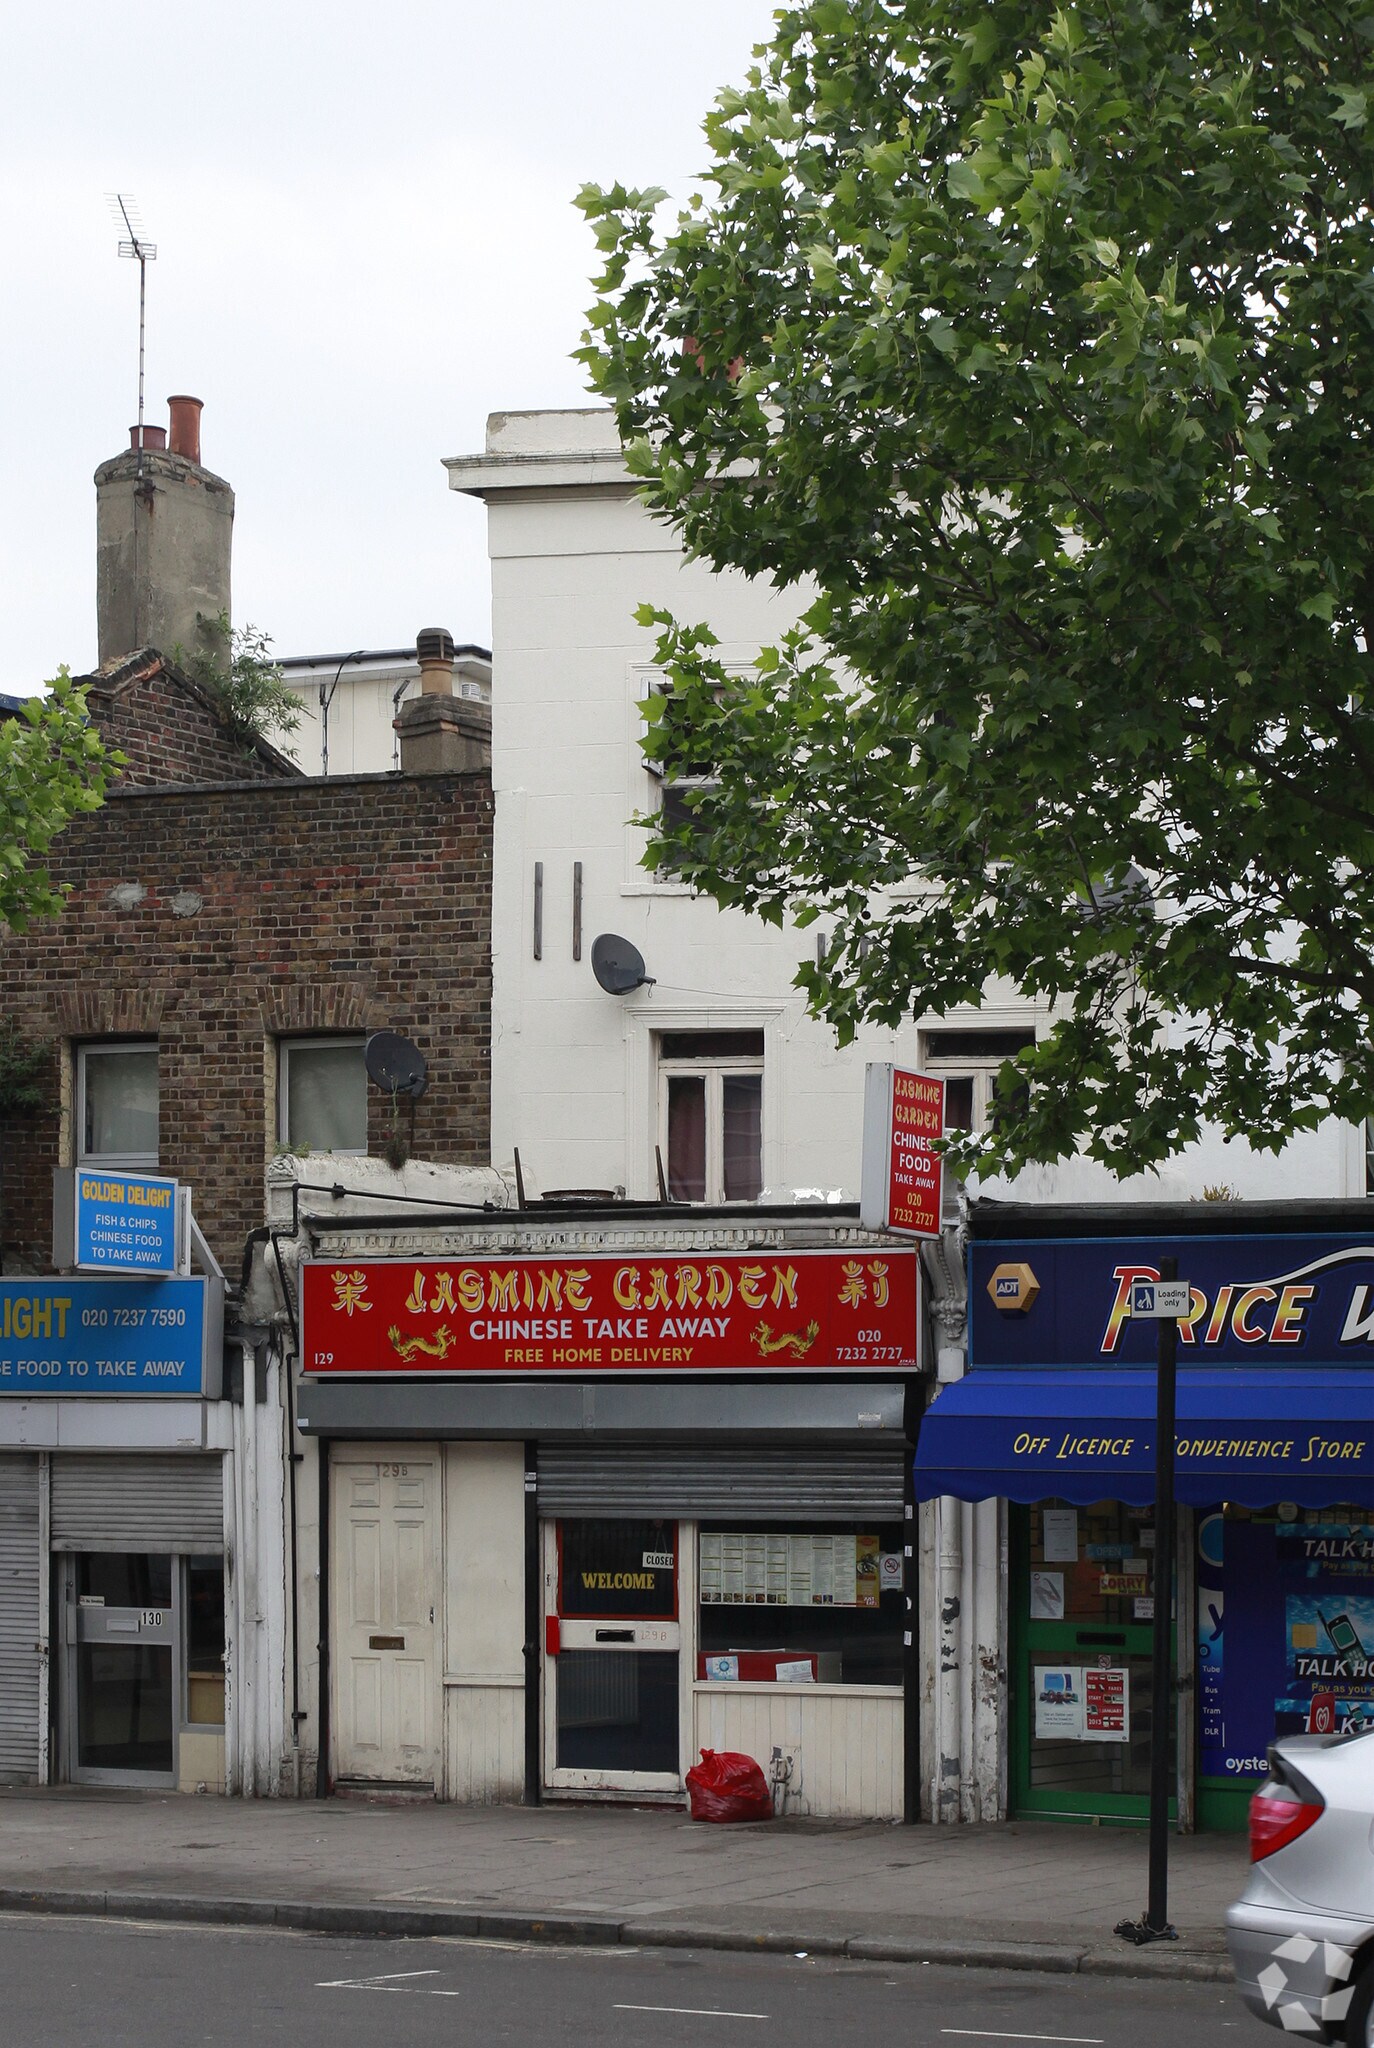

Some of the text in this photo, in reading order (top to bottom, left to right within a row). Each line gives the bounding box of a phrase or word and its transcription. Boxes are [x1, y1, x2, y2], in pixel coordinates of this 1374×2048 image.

[895, 1077, 940, 1105] JASMINE
[895, 1104, 939, 1131] GARDEN
[893, 1131, 939, 1154] CHINES
[899, 1153, 931, 1173] FOOD
[894, 1172, 936, 1190] TAKE AWAY
[82, 1179, 172, 1208] GOLDEN DELIGHT
[907, 1192, 922, 1207] 020
[95, 1214, 157, 1230] FISH & CHIPS
[894, 1207, 934, 1226] 7232 2727
[90, 1230, 163, 1247] CHINESE FOOD
[92, 1247, 162, 1263] TO TAKE AWAY
[405, 1264, 799, 1315] JASMINE GARDEN
[996, 1281, 1020, 1295] ADT
[1157, 1290, 1187, 1299] Loading
[1100, 1265, 1318, 1353] PRICE
[1164, 1299, 1180, 1308] only
[0, 1297, 186, 1339] IGHT 020 7237 7590
[469, 1317, 731, 1340] CHINESE TAKE AWAY
[857, 1330, 882, 1342] 020
[314, 1352, 334, 1365] 129
[504, 1347, 694, 1363] FREE HOME DELIVERY
[836, 1347, 903, 1360] 7232 2727
[0, 1360, 186, 1376] E FOOD TO TAKE AWAY
[1013, 1432, 1050, 1455] OFF
[1056, 1433, 1134, 1459] LICENCE
[1174, 1436, 1294, 1459] ONVENIENCE
[1301, 1436, 1366, 1462] STORE
[1303, 1540, 1357, 1558] TALK
[646, 1555, 675, 1567] CLOSED
[1322, 1561, 1339, 1571] Pay
[581, 1572, 655, 1590] WELCOME
[142, 1612, 162, 1626] 130
[1202, 1665, 1220, 1673] Tube
[1297, 1658, 1350, 1677] TALK
[1311, 1683, 1331, 1693] Pay
[1348, 1686, 1367, 1695] you
[1204, 1727, 1219, 1735] DLR
[1302, 1715, 1357, 1734] TK
